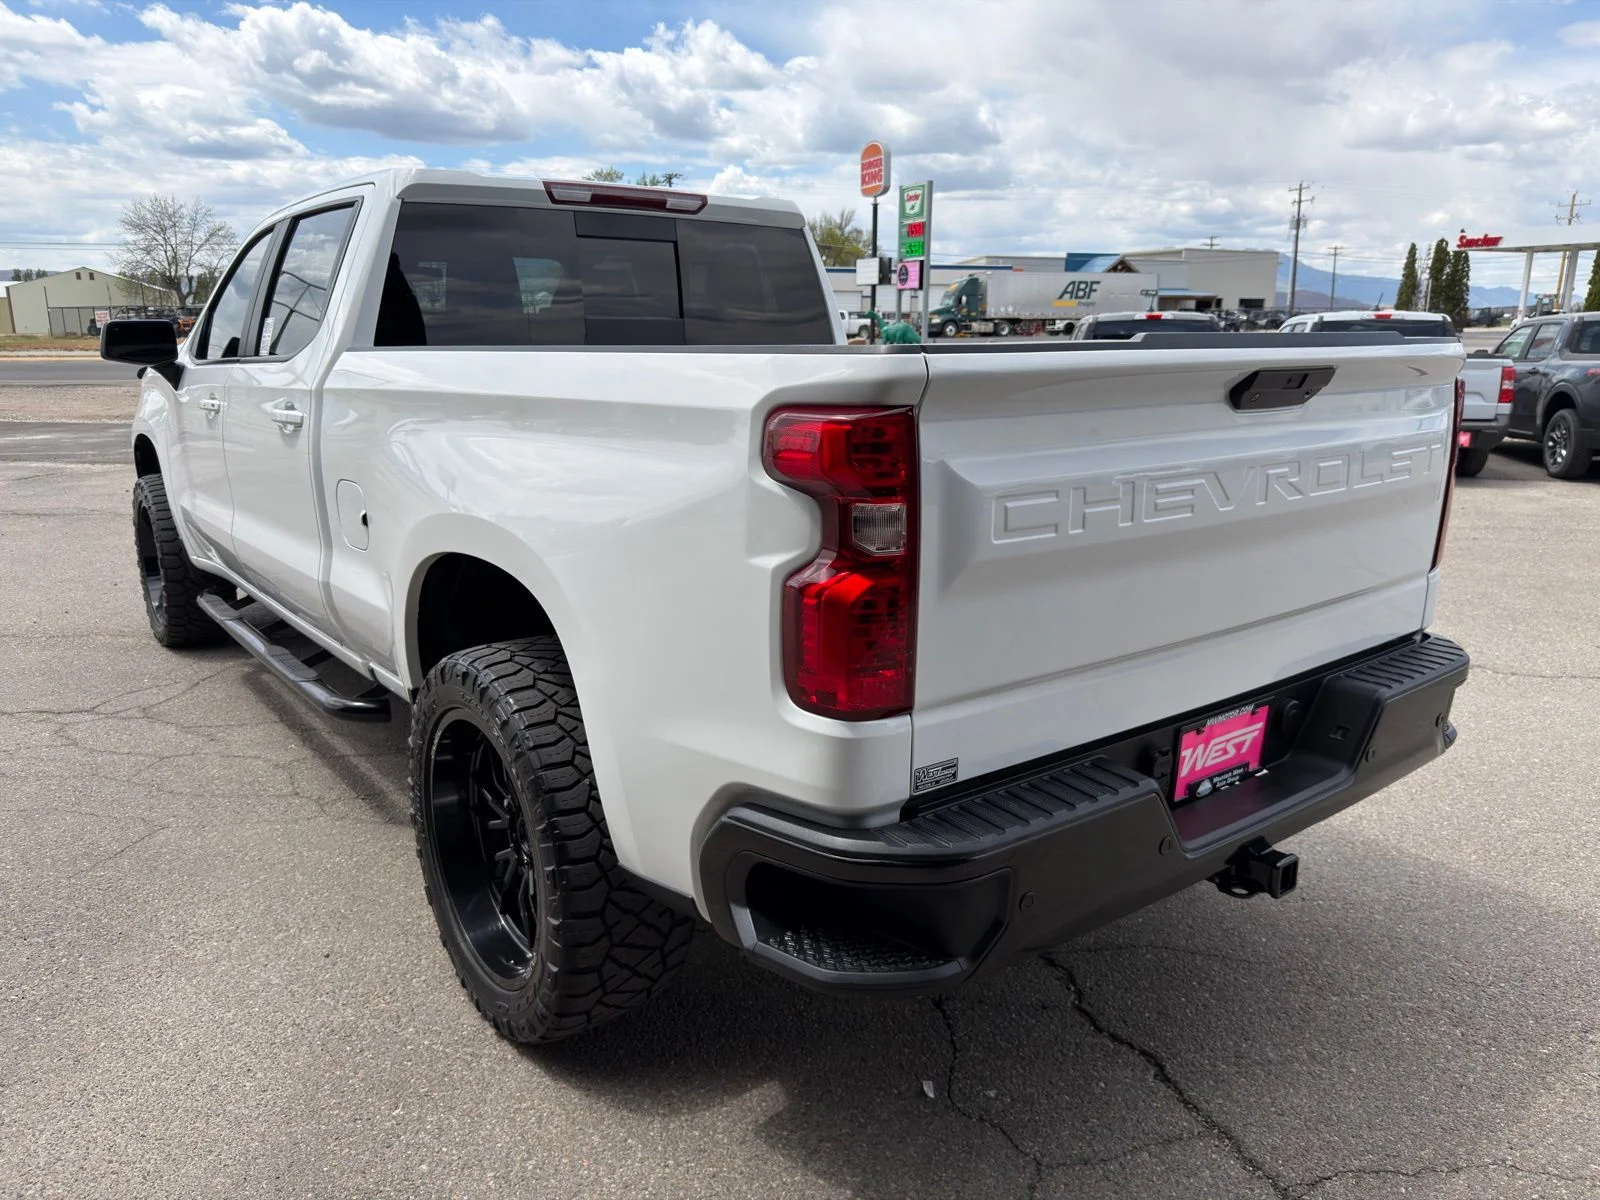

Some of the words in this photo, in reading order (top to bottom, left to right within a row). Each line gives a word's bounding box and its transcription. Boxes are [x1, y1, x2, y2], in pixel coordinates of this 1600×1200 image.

[861, 157, 883, 171] BURGER
[861, 169, 883, 188] KING
[1057, 281, 1101, 300] ABF
[991, 442, 1443, 545] CHEVROLET
[1180, 722, 1264, 777] WEST
